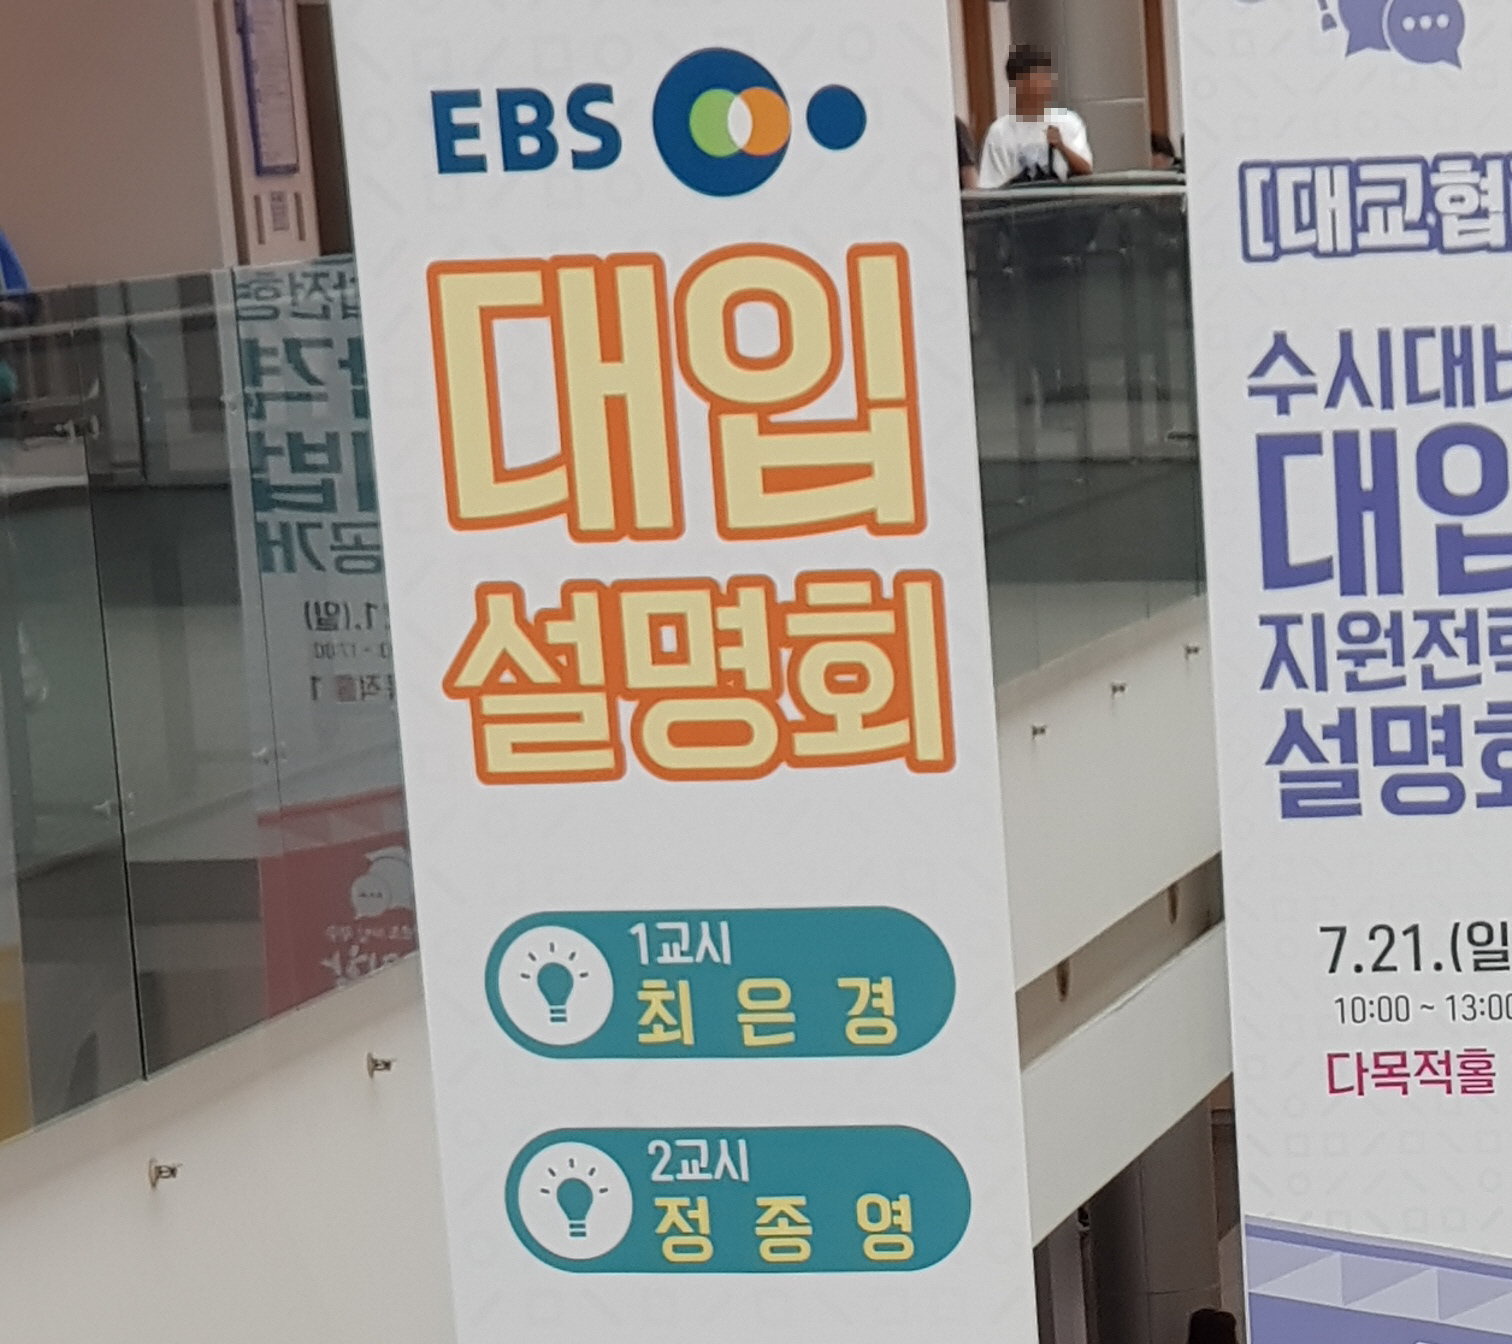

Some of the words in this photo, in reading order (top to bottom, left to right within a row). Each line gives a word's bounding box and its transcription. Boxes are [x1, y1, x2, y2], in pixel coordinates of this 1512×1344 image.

[430, 83, 622, 175] EBS
[426, 243, 927, 541] 대입
[443, 570, 956, 785] 설명회
[630, 921, 732, 965] 1교시
[1334, 995, 1410, 1024] 10:00
[1327, 1048, 1496, 1096] 다목적홀
[647, 1139, 749, 1182] 2교시
